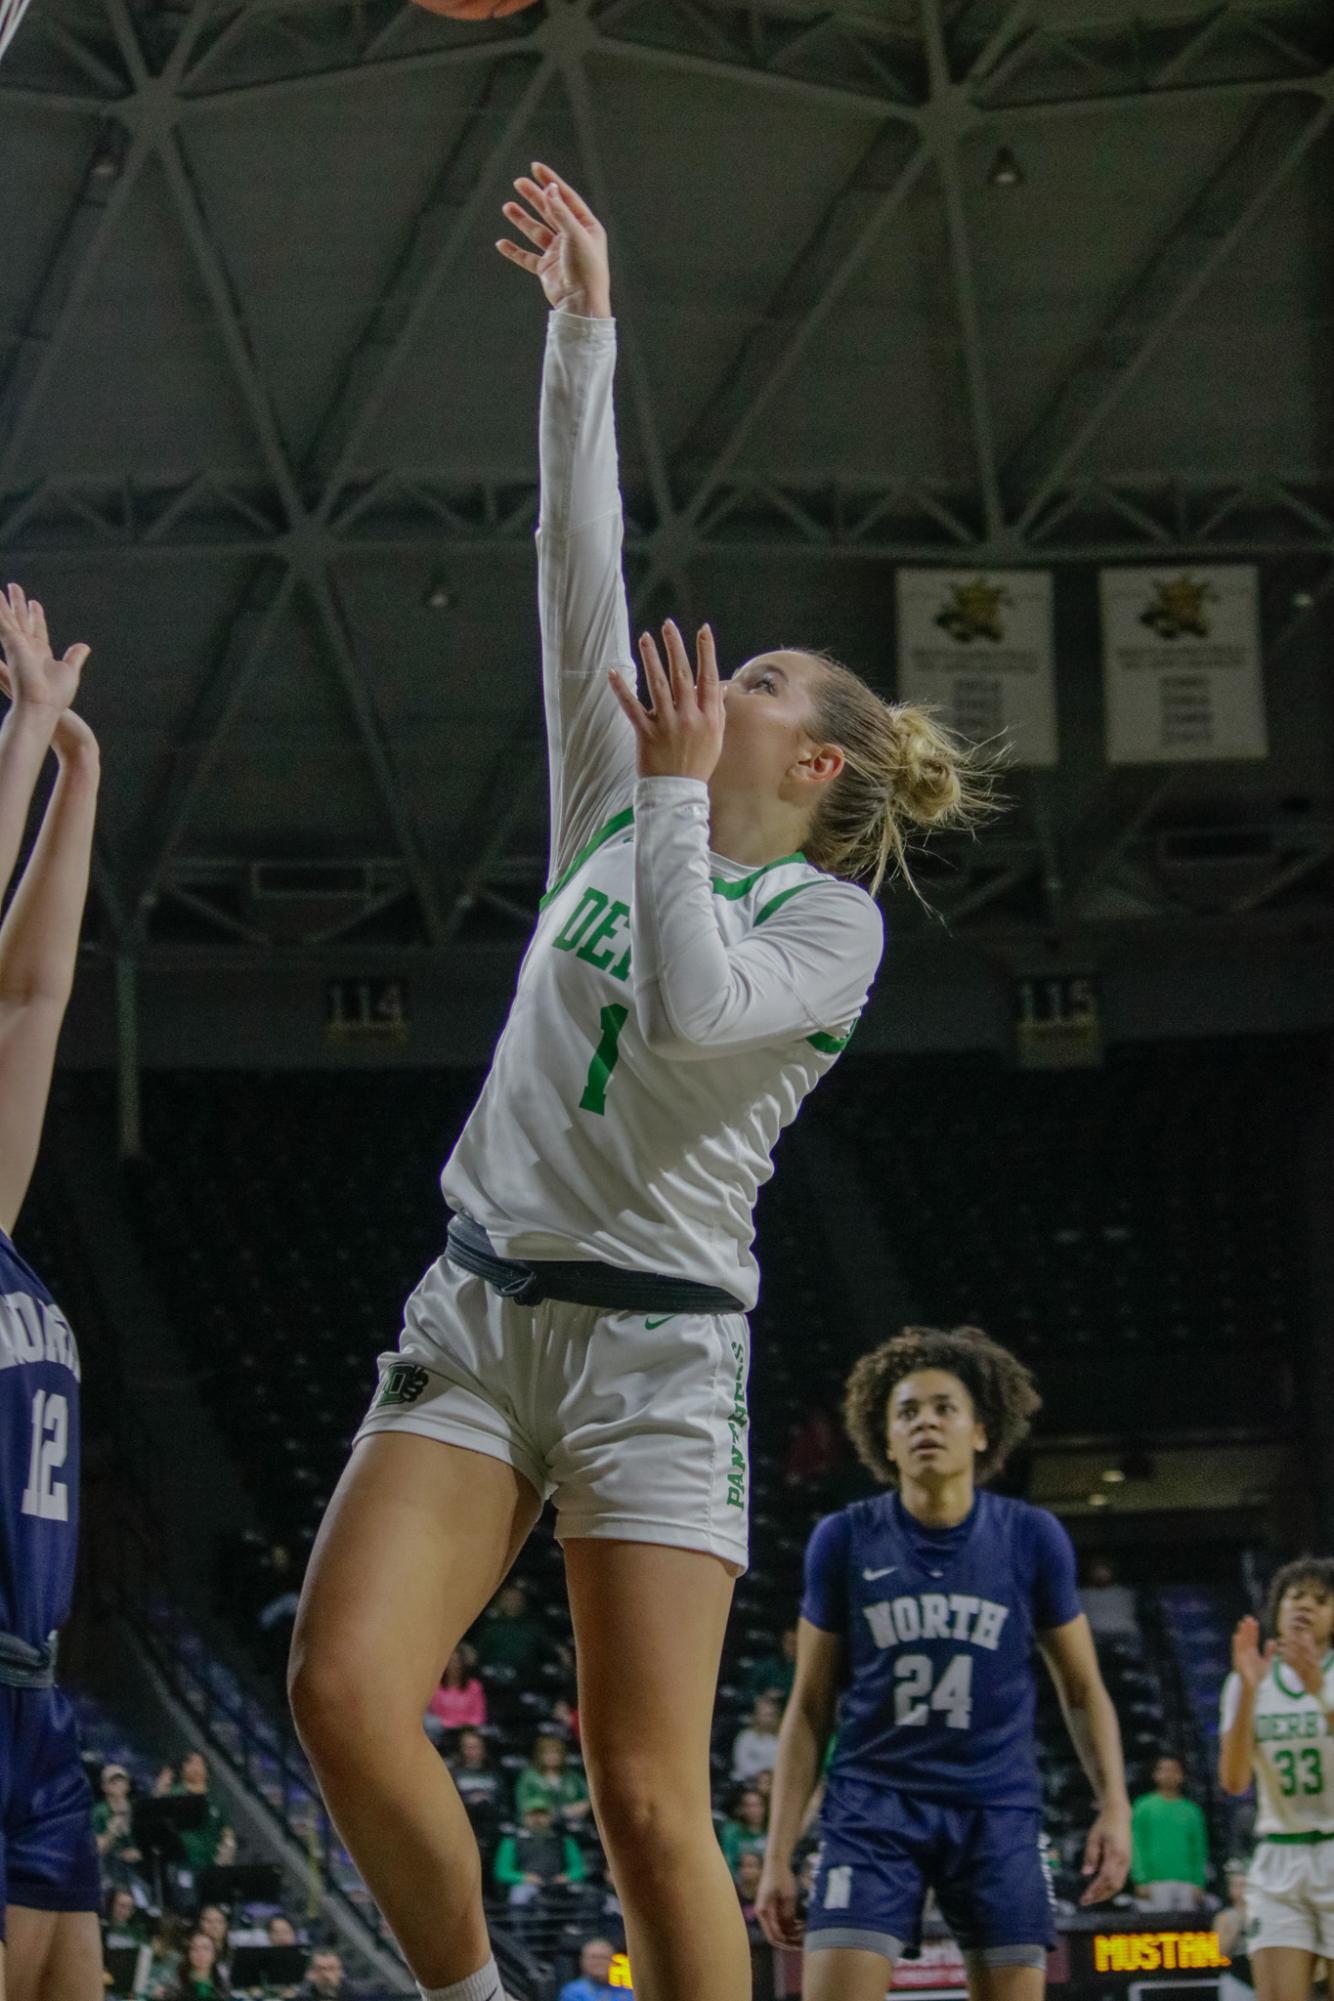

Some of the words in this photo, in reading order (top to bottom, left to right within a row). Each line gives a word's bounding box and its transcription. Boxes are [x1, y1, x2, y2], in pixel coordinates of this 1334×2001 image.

[579, 1003, 629, 1117] 1
[21, 1389, 69, 1521] 12
[863, 1593, 1010, 1650] NORTH
[893, 1653, 974, 1730] 24
[1274, 1748, 1324, 1798] 33
[1093, 1932, 1231, 1974] MUSTAN
